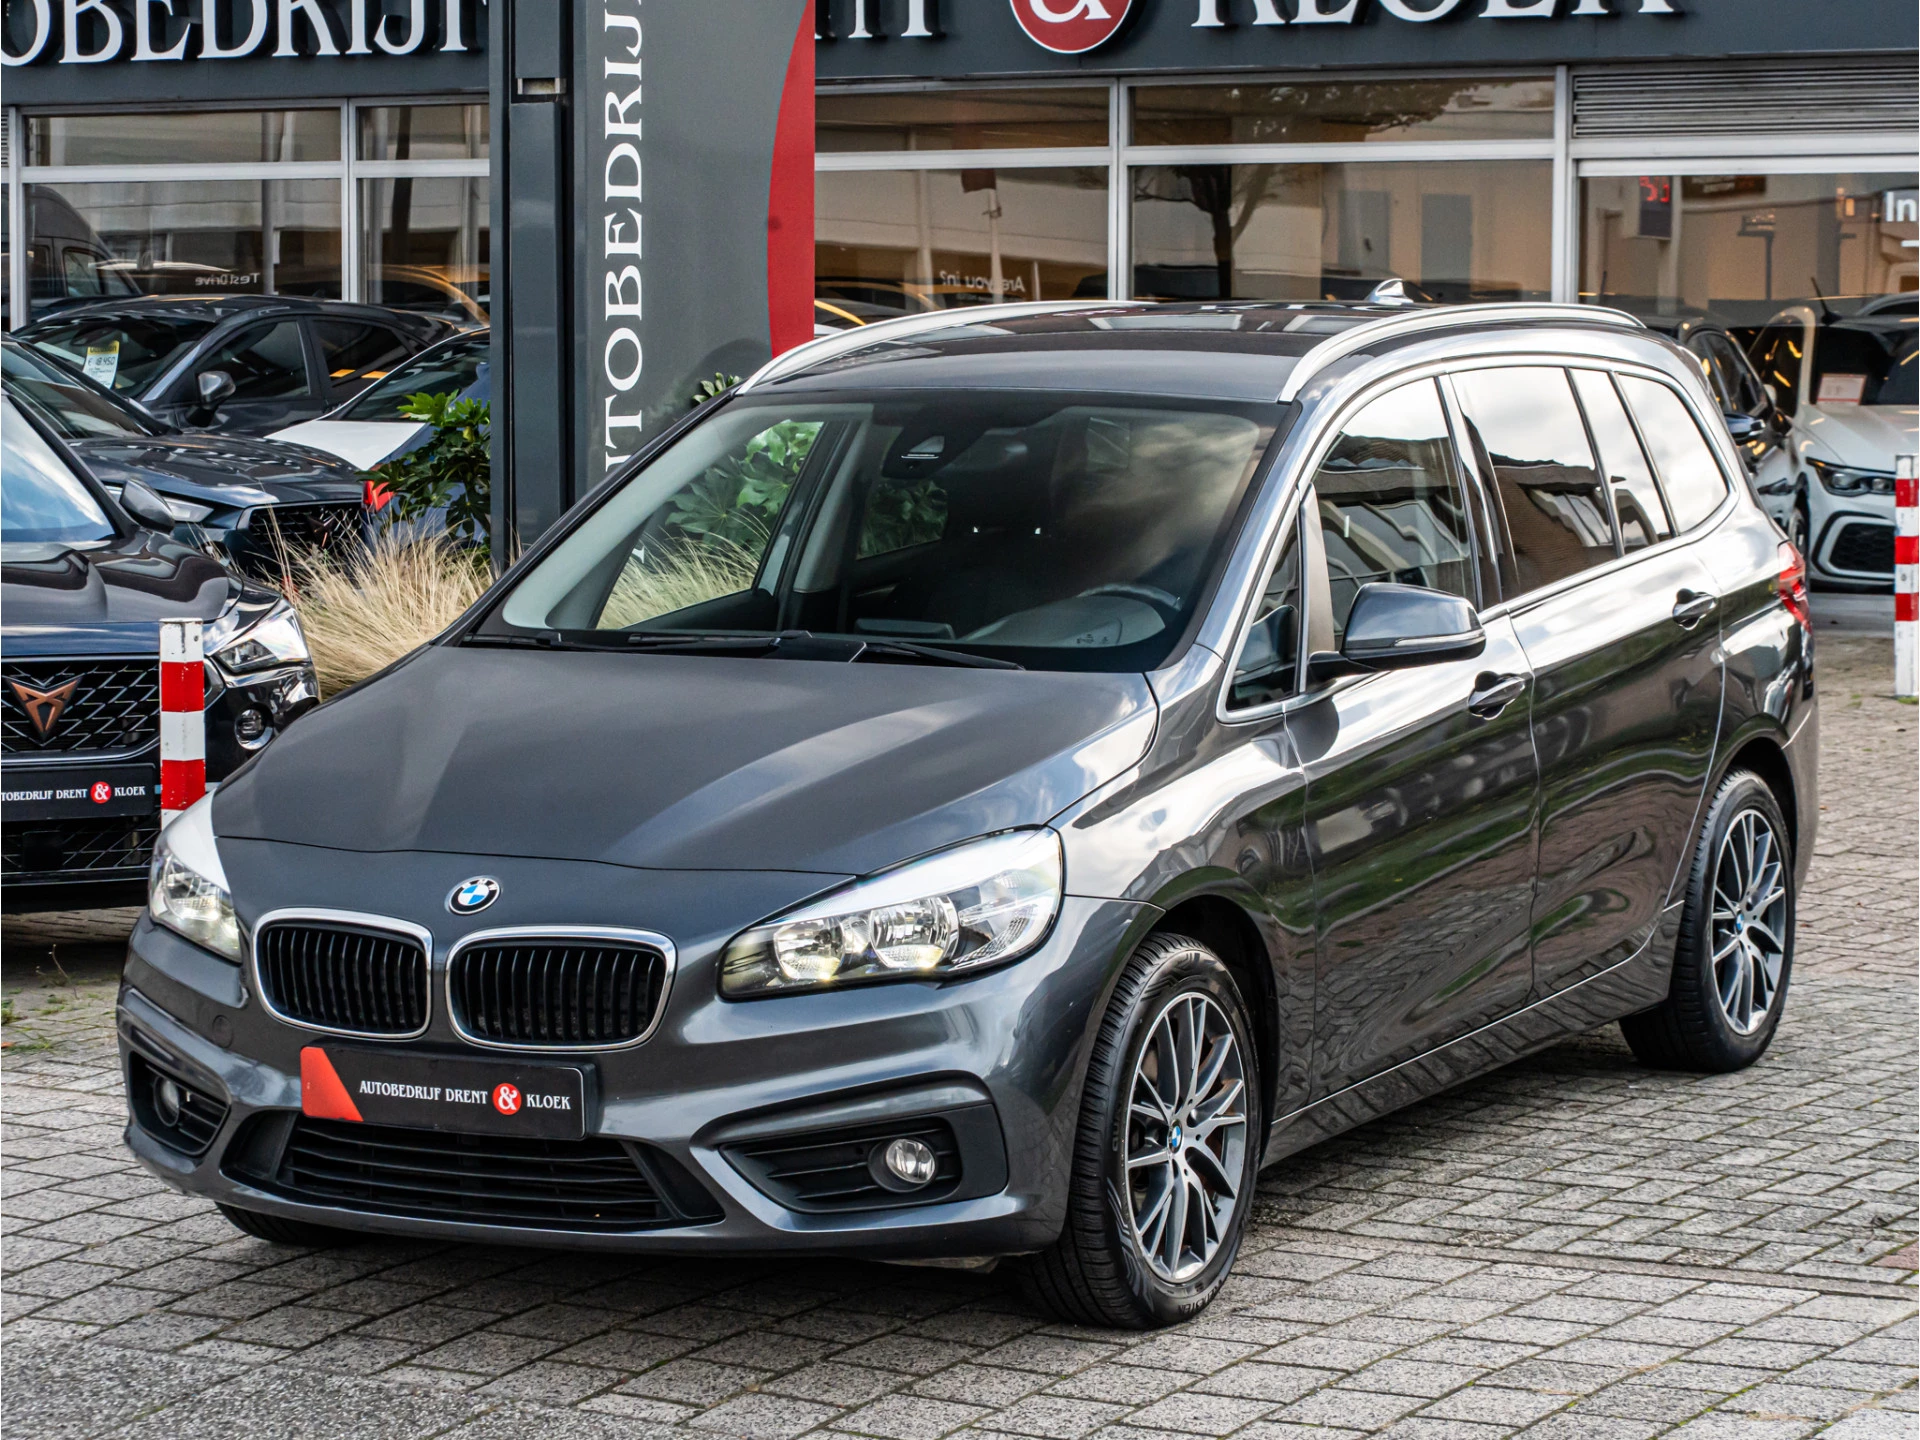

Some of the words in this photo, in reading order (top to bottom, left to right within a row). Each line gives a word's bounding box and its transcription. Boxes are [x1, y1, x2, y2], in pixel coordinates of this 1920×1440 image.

[605, 0, 642, 472] TOBEDRIJ
[56, 789, 88, 799] DRENT
[94, 783, 109, 800] &
[114, 786, 146, 797] KLOEK
[359, 1080, 442, 1101] AUTOBEDRIJF
[445, 1087, 488, 1105] DRENT
[498, 1086, 517, 1111] &
[526, 1094, 571, 1110] KLOEK
